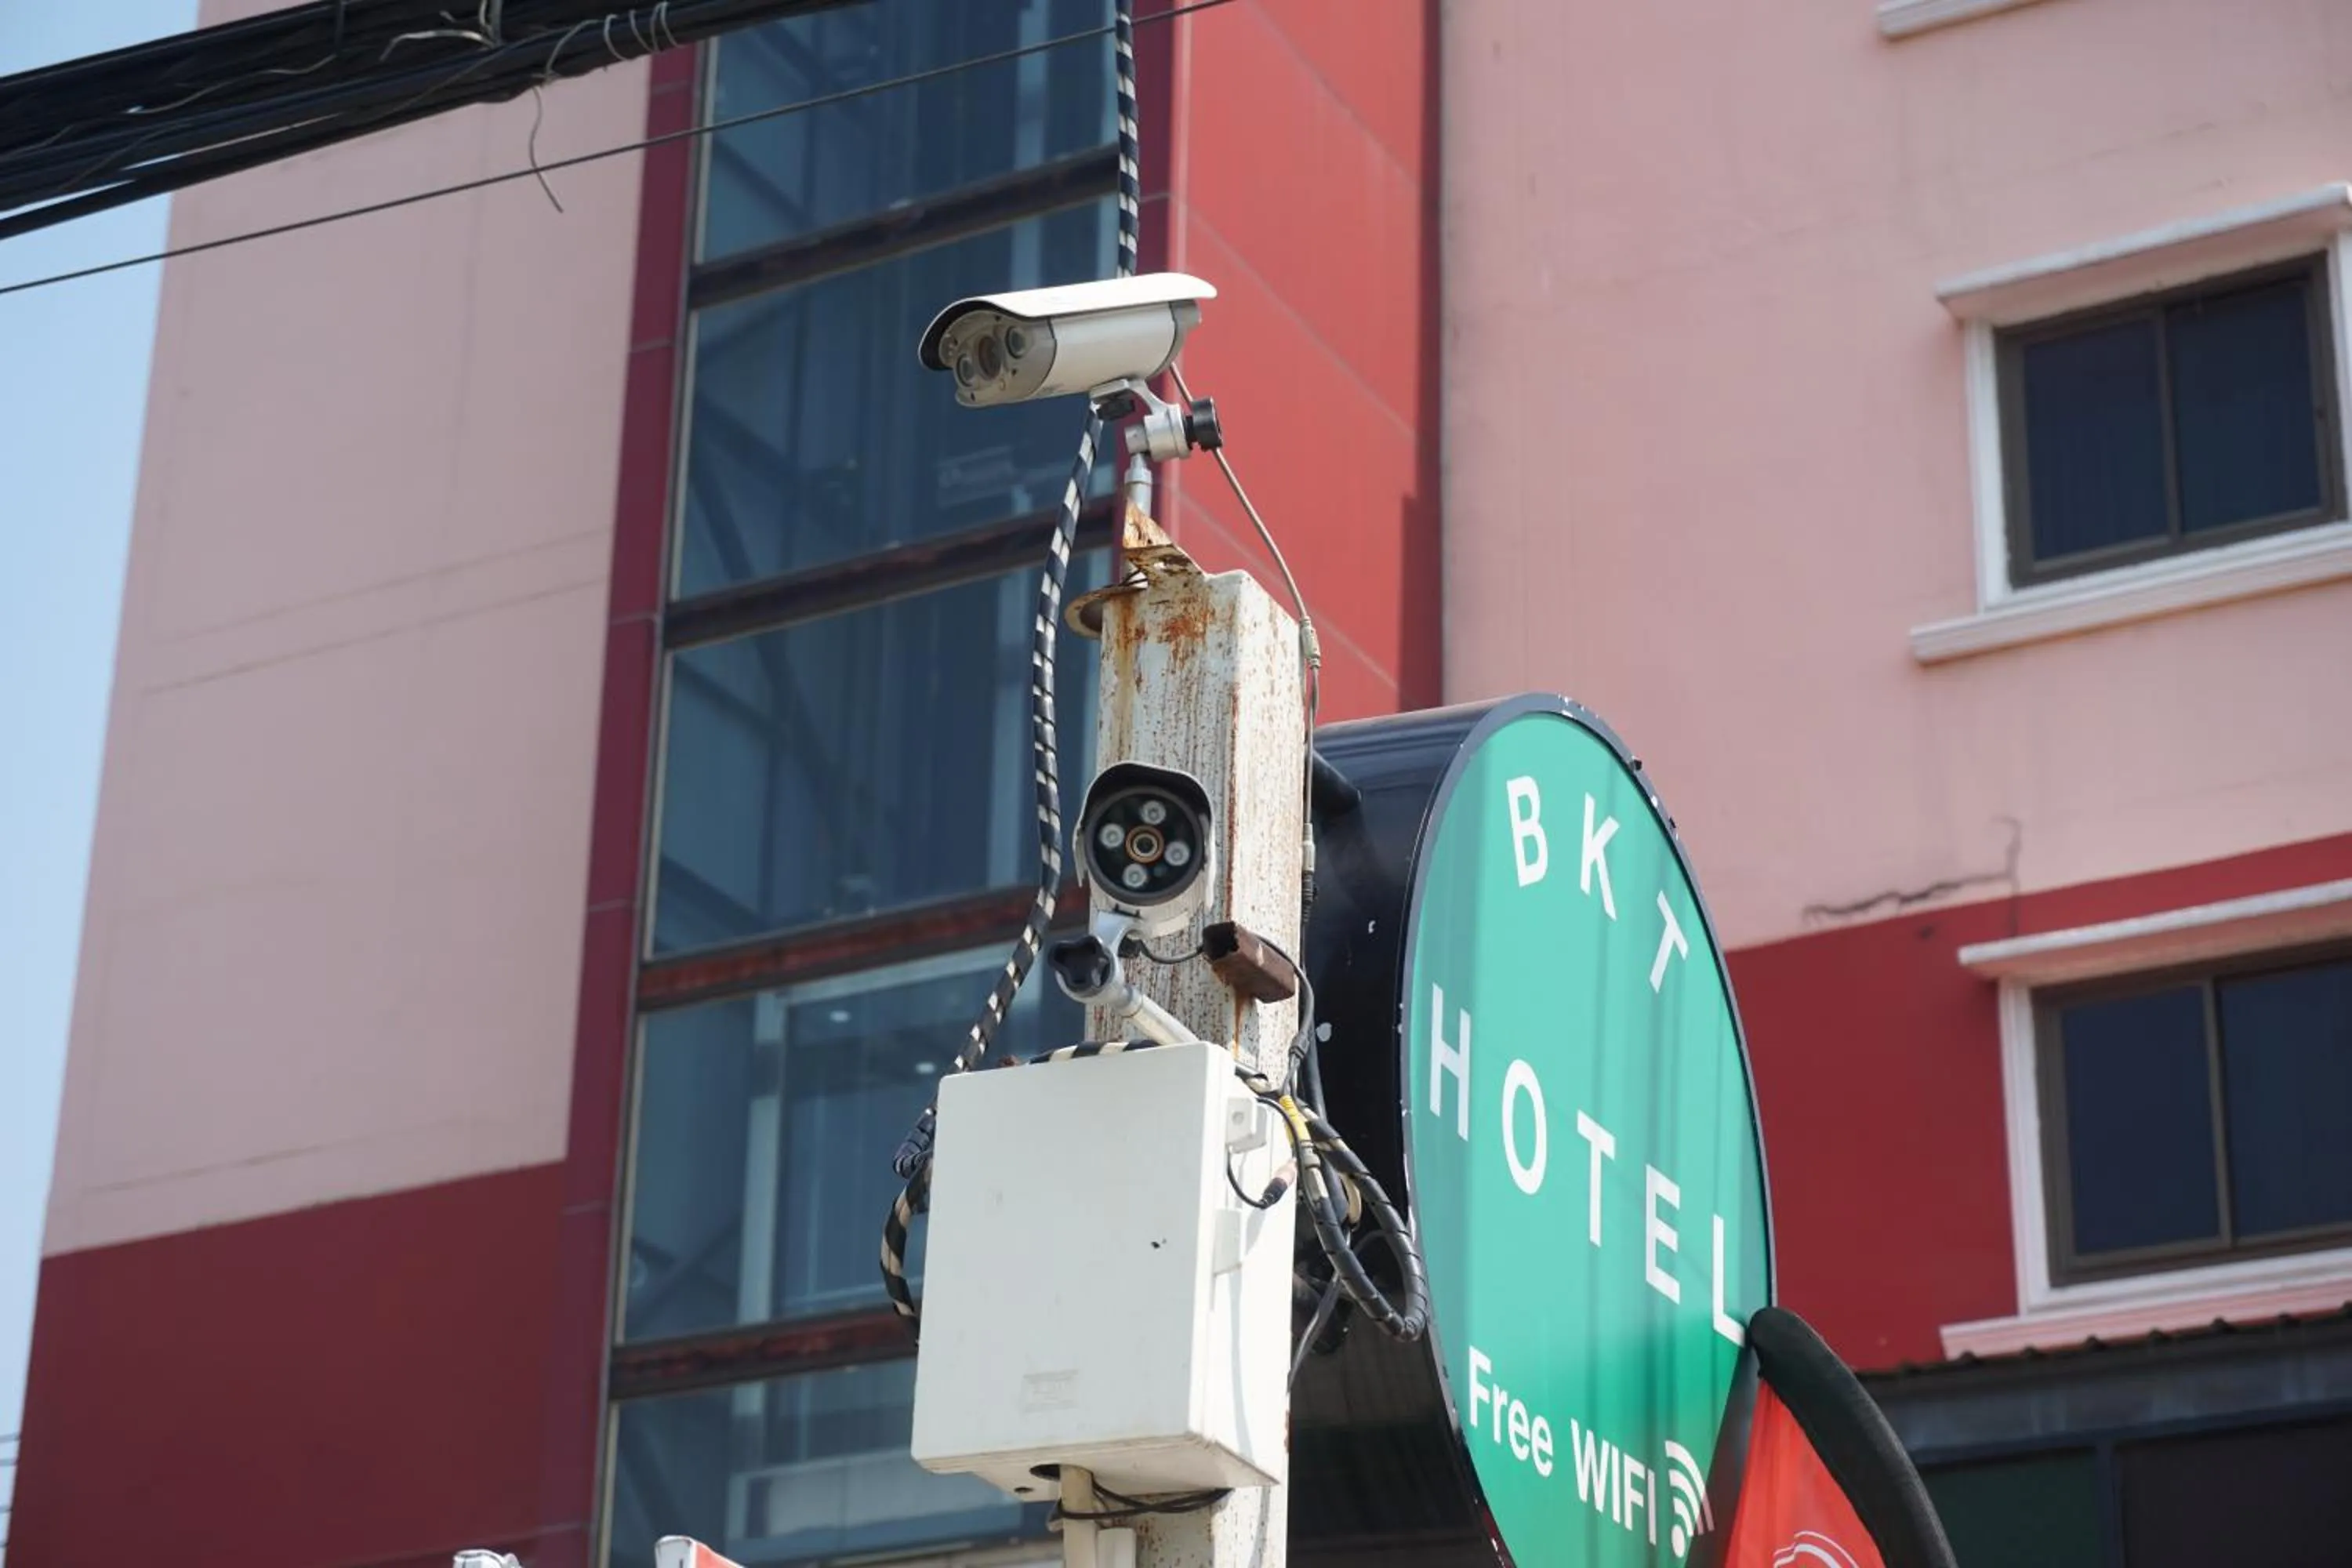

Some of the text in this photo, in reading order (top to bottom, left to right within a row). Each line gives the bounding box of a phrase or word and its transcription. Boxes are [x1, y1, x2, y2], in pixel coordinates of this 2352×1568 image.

[1506, 775, 1689, 993] BKT
[1428, 982, 1744, 1348] HOTEL
[1468, 1345, 1657, 1546] Free WIFI
